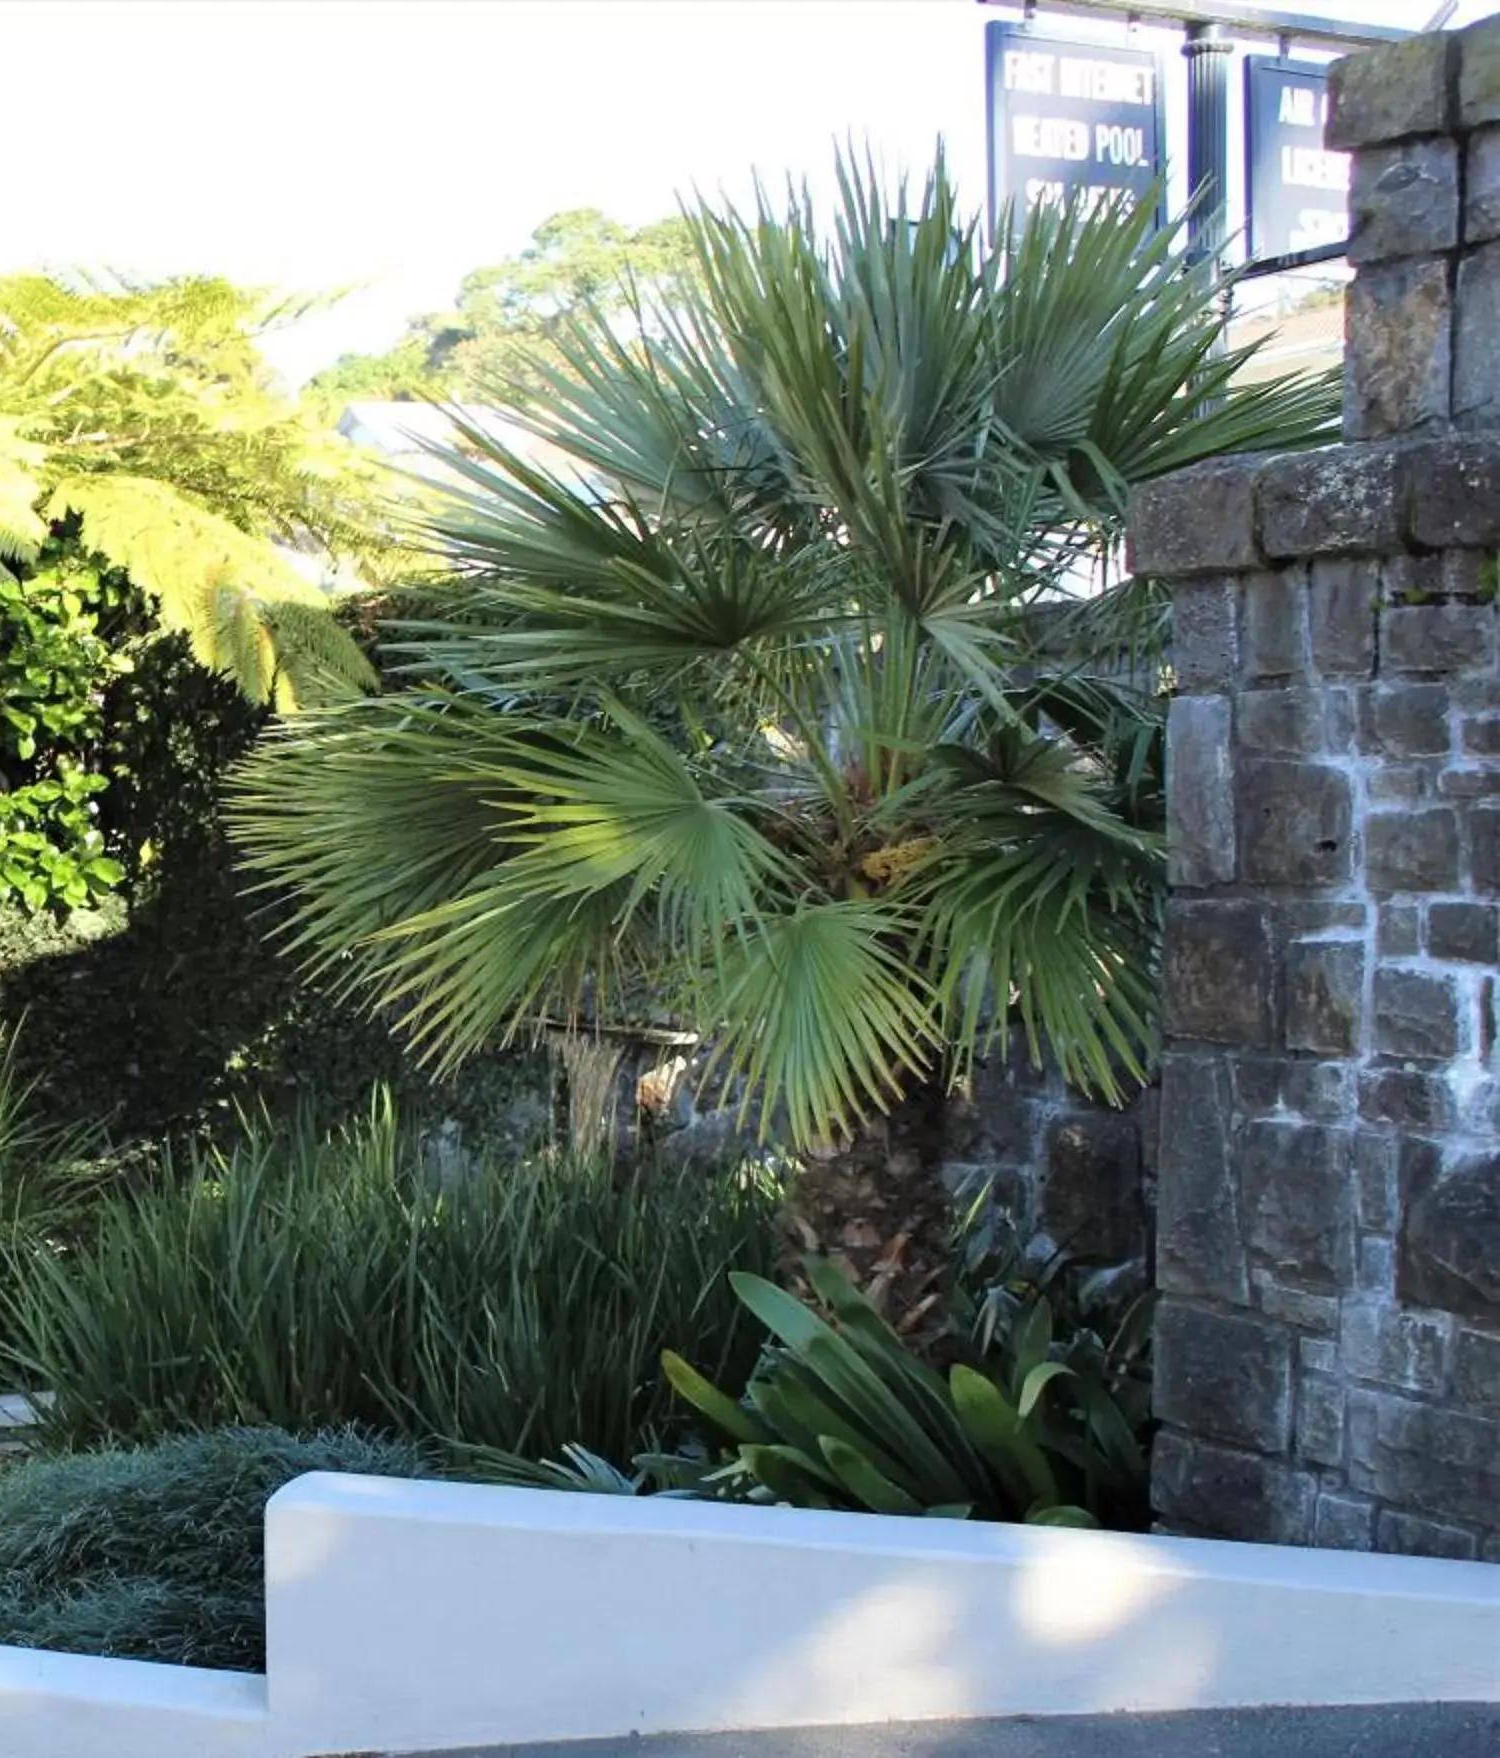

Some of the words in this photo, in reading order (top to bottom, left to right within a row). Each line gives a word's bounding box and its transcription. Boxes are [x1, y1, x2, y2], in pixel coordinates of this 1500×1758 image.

[1005, 50, 1055, 93] FAST
[1060, 57, 1155, 104] INTERNET
[1279, 86, 1315, 126] AIR
[1012, 115, 1088, 160] HEATED
[1096, 124, 1148, 167] POOL
[1282, 146, 1351, 192] LICENS
